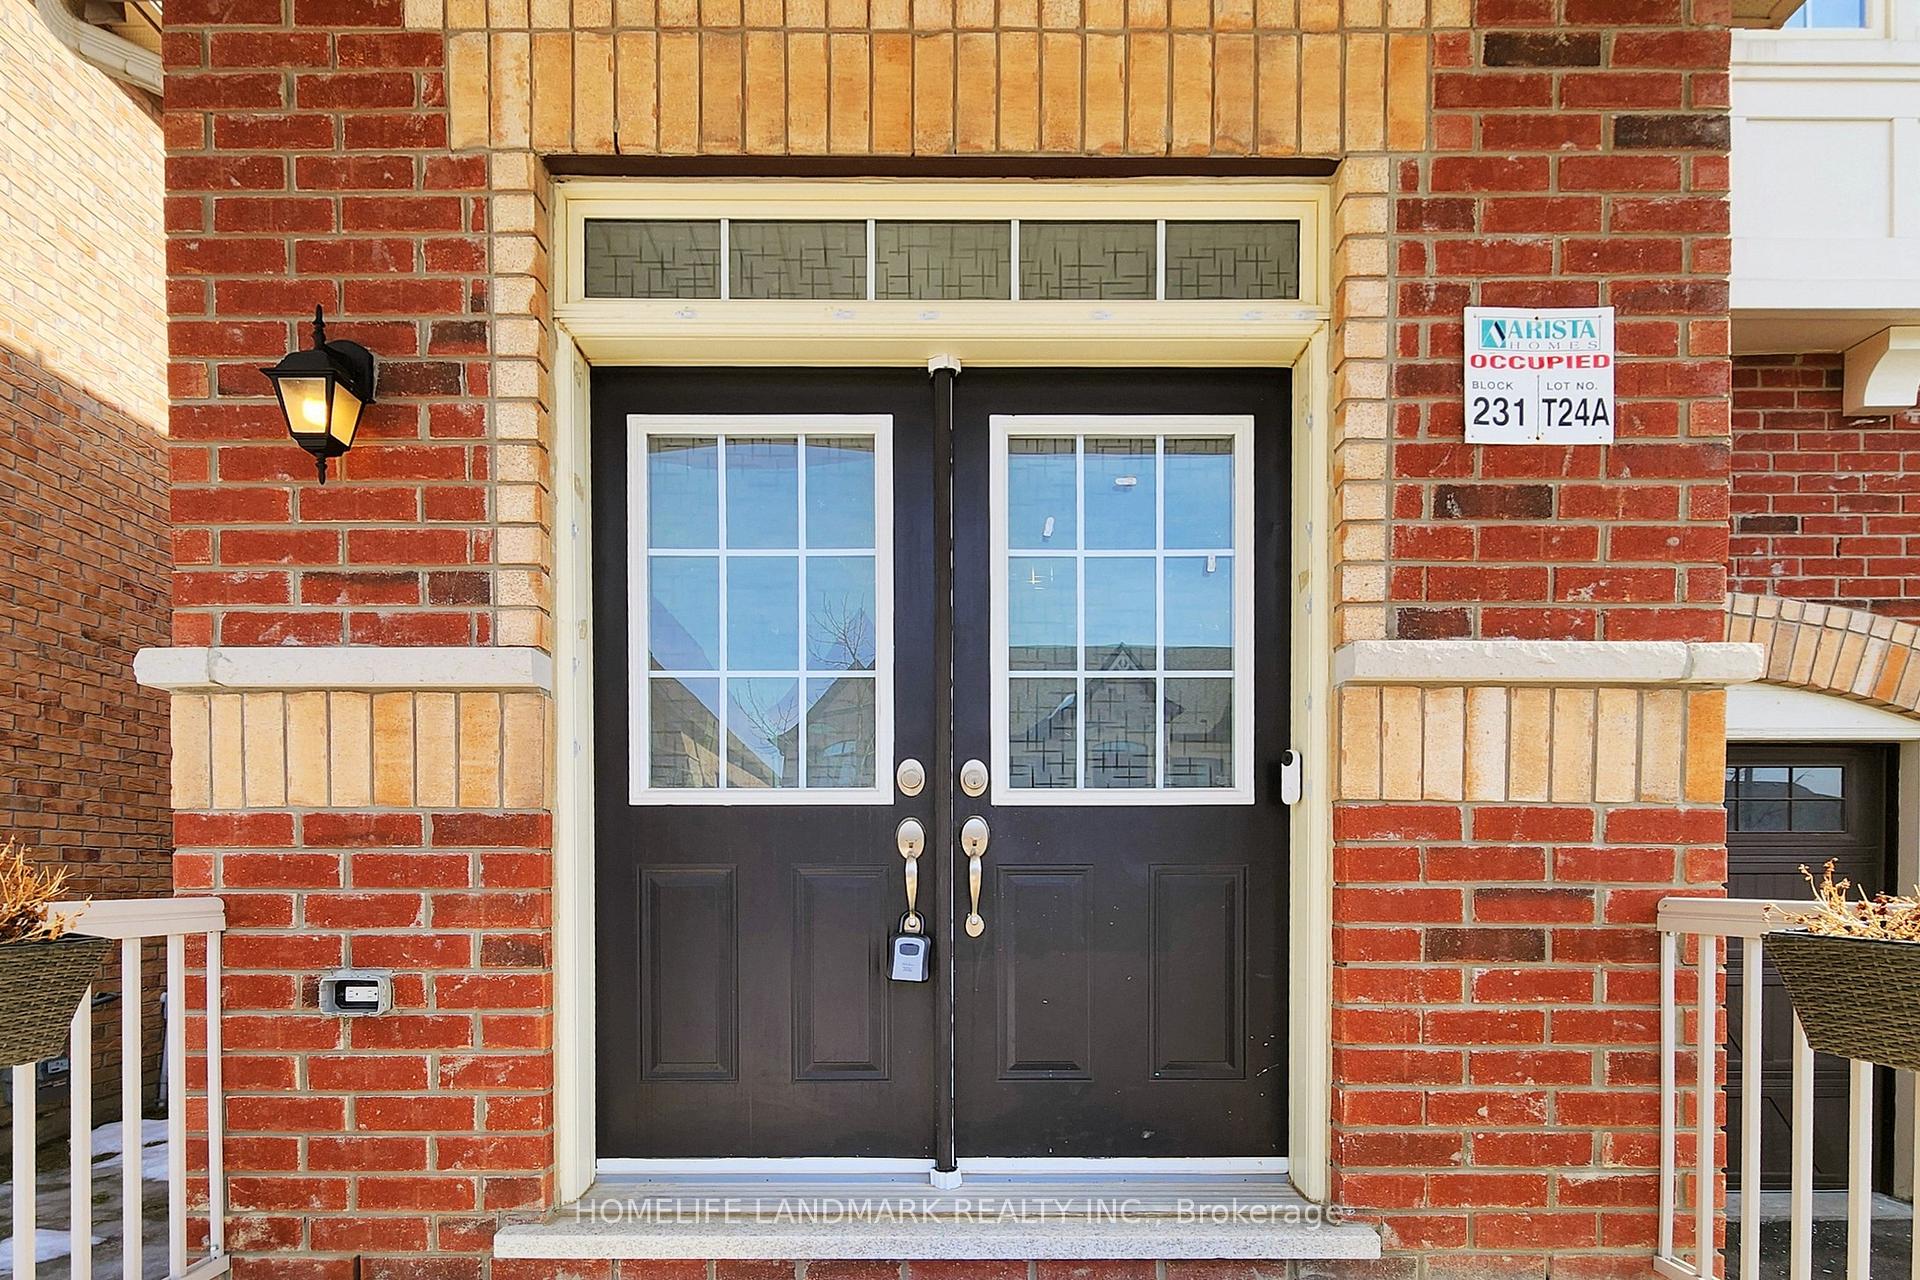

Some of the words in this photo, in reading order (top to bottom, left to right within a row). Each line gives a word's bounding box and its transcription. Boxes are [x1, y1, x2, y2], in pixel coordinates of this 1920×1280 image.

[1508, 319, 1596, 339] ARISTA
[1510, 341, 1598, 350] HOMES
[1470, 354, 1610, 370] OCCUPIED
[1472, 381, 1514, 390] BLOCK
[1546, 382, 1570, 391] LOT
[1576, 382, 1598, 391] NO.
[1473, 396, 1525, 426] 231
[1541, 397, 1610, 426] T24A
